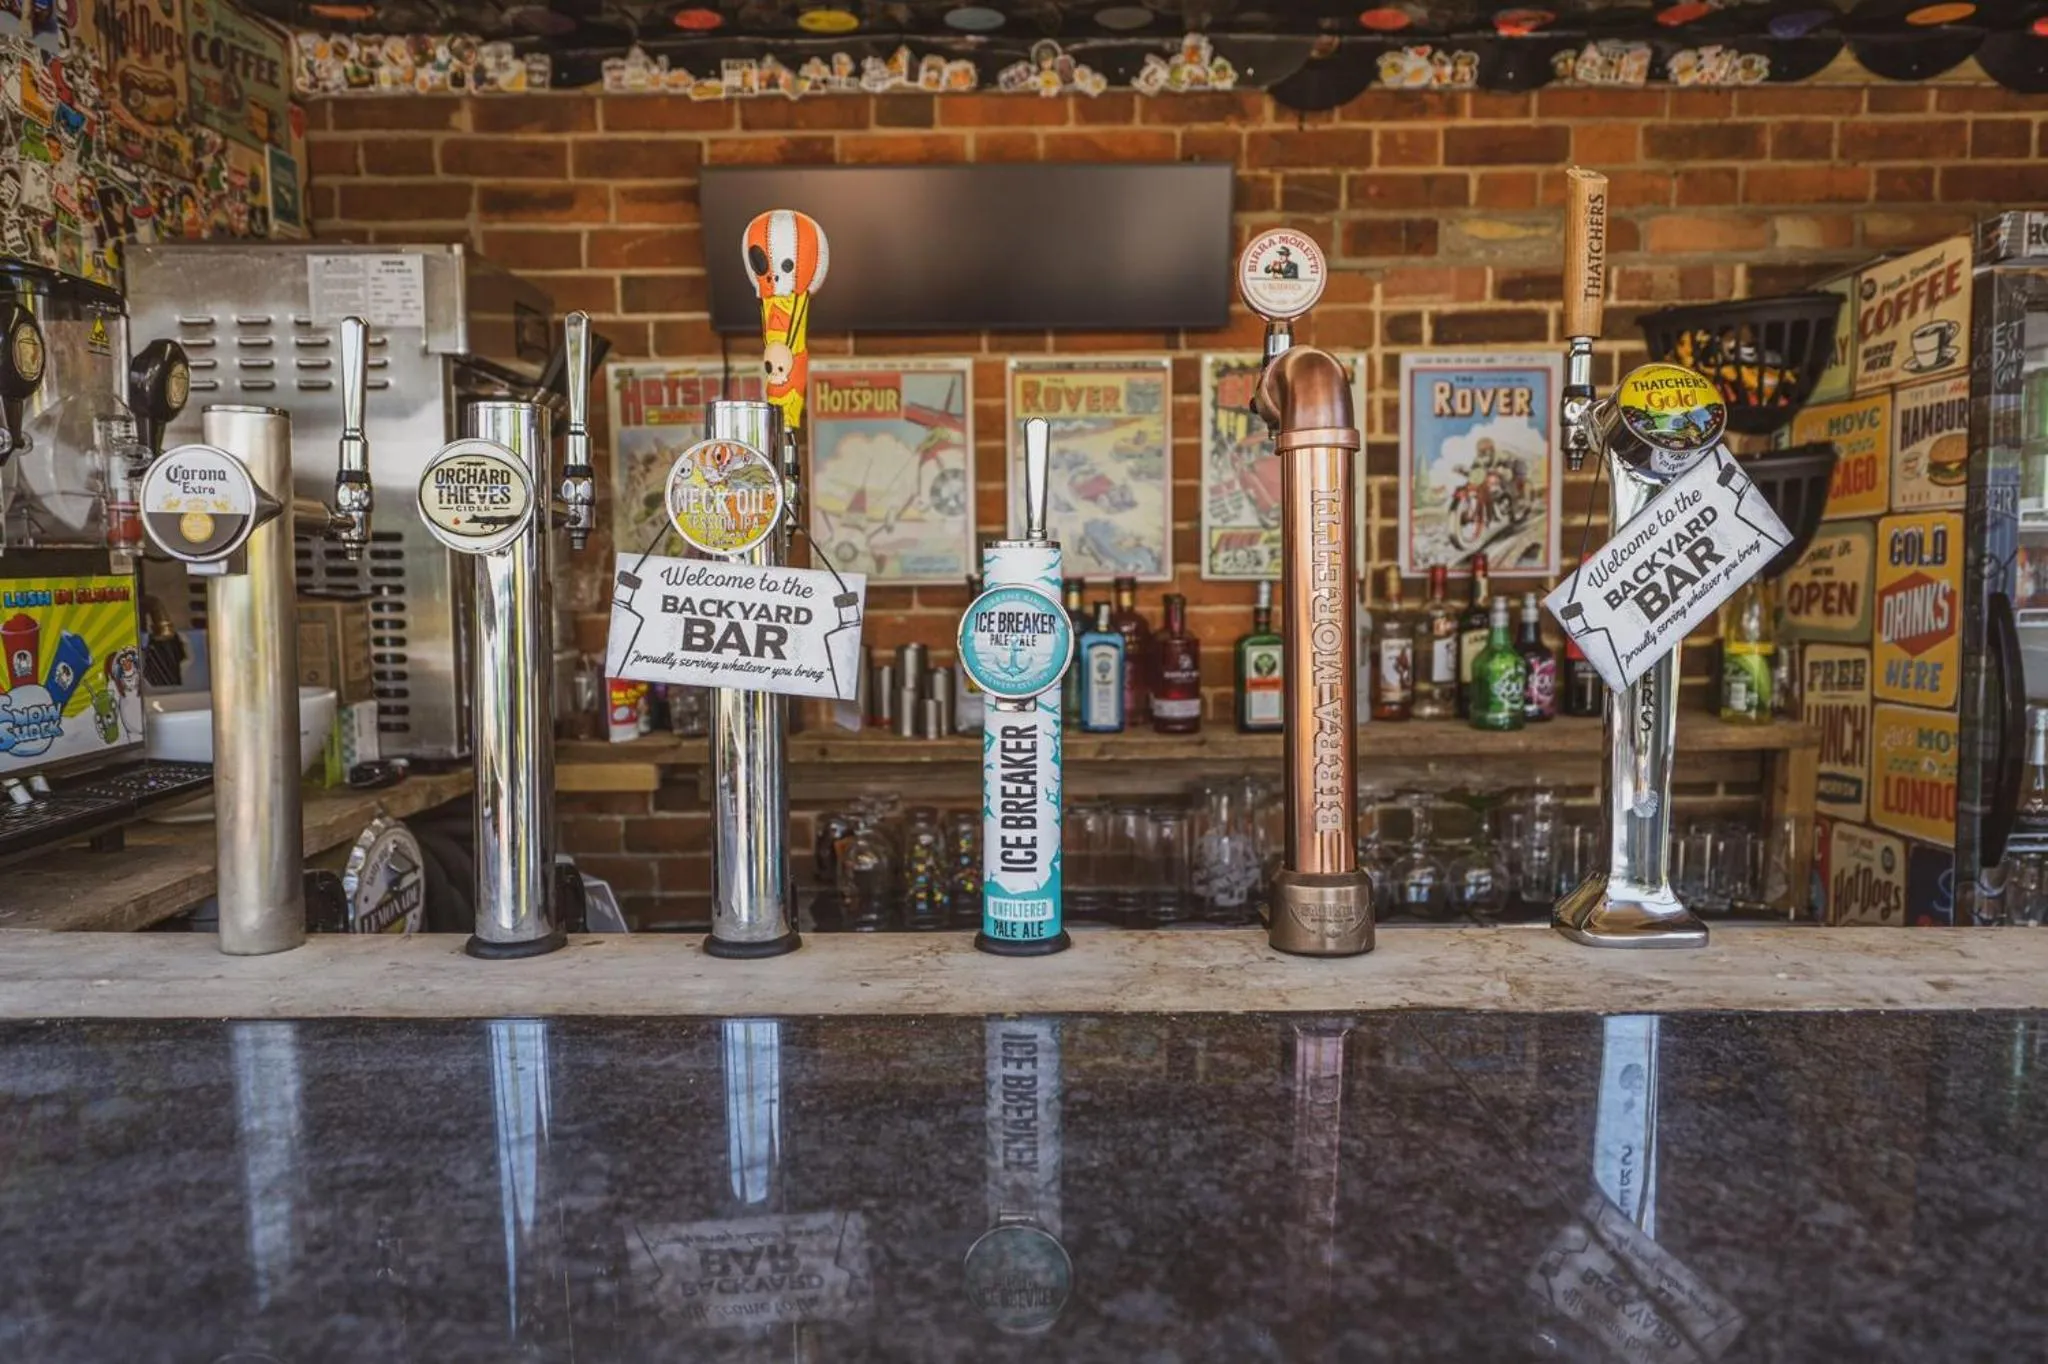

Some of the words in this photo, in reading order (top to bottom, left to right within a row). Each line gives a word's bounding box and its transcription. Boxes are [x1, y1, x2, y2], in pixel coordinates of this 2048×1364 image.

[192, 30, 281, 89] COFFEE
[1248, 238, 1277, 273] BIRRA
[1278, 235, 1320, 275] MORETTI
[1583, 192, 1605, 302] THATCHERS
[1860, 257, 1965, 344] COFFEE
[816, 379, 899, 414] HOTSPUR
[1021, 379, 1122, 414] ROVER
[1433, 381, 1535, 418] ROVER
[1631, 376, 1708, 393] THATCHERS
[1644, 388, 1699, 412] Gold
[1828, 405, 1882, 437] MOVE
[1900, 397, 1969, 452] HAMBUR
[165, 464, 228, 487] Corona
[182, 481, 216, 495] Extra
[434, 467, 512, 486] ORCHARD
[1829, 452, 1878, 501] CAGO
[434, 485, 512, 505] THIEVES
[455, 505, 491, 513] CIDER
[675, 488, 730, 515] NECK
[736, 488, 770, 514] OIL
[687, 515, 737, 532] SESSION
[740, 515, 761, 530] IPA
[1586, 523, 1660, 589] Welcome
[1657, 510, 1677, 526] to
[1674, 489, 1704, 516] the
[1603, 505, 1719, 611] BACKYARD
[1889, 524, 1949, 567] COLD
[659, 566, 757, 589] Welcome
[758, 571, 781, 593] to
[781, 576, 815, 600] the
[1311, 488, 1345, 686] MORETTI
[1633, 535, 1726, 624] BAR
[3, 589, 52, 609] LUSH
[660, 593, 814, 626] BACKYARD
[1656, 604, 1689, 639] serving
[1686, 576, 1725, 609] whatever
[1722, 562, 1739, 584] you
[1787, 580, 1859, 617] OPEN
[1881, 577, 1952, 645] DRINKS
[681, 616, 789, 661] BAR
[975, 611, 997, 633] ICE
[997, 611, 1057, 635] BREAKER
[989, 635, 1010, 647] PALE
[1019, 635, 1038, 647] ALE
[678, 657, 722, 673] serving
[720, 659, 771, 675] whatever
[770, 665, 792, 680] you
[1807, 658, 1867, 693] FREE
[1885, 659, 1945, 692] HERE
[1916, 726, 1958, 755] MO
[1000, 723, 1038, 830] BREAKER
[1313, 697, 1346, 834] BIRRA
[1883, 775, 1957, 824] LONDO
[1000, 834, 1038, 873] ICE
[991, 900, 1049, 919] UNFILTERED
[1834, 863, 1861, 919] Hot
[1860, 866, 1903, 922] Dogs
[992, 920, 1018, 939] PALE
[1021, 920, 1045, 938] ALE
